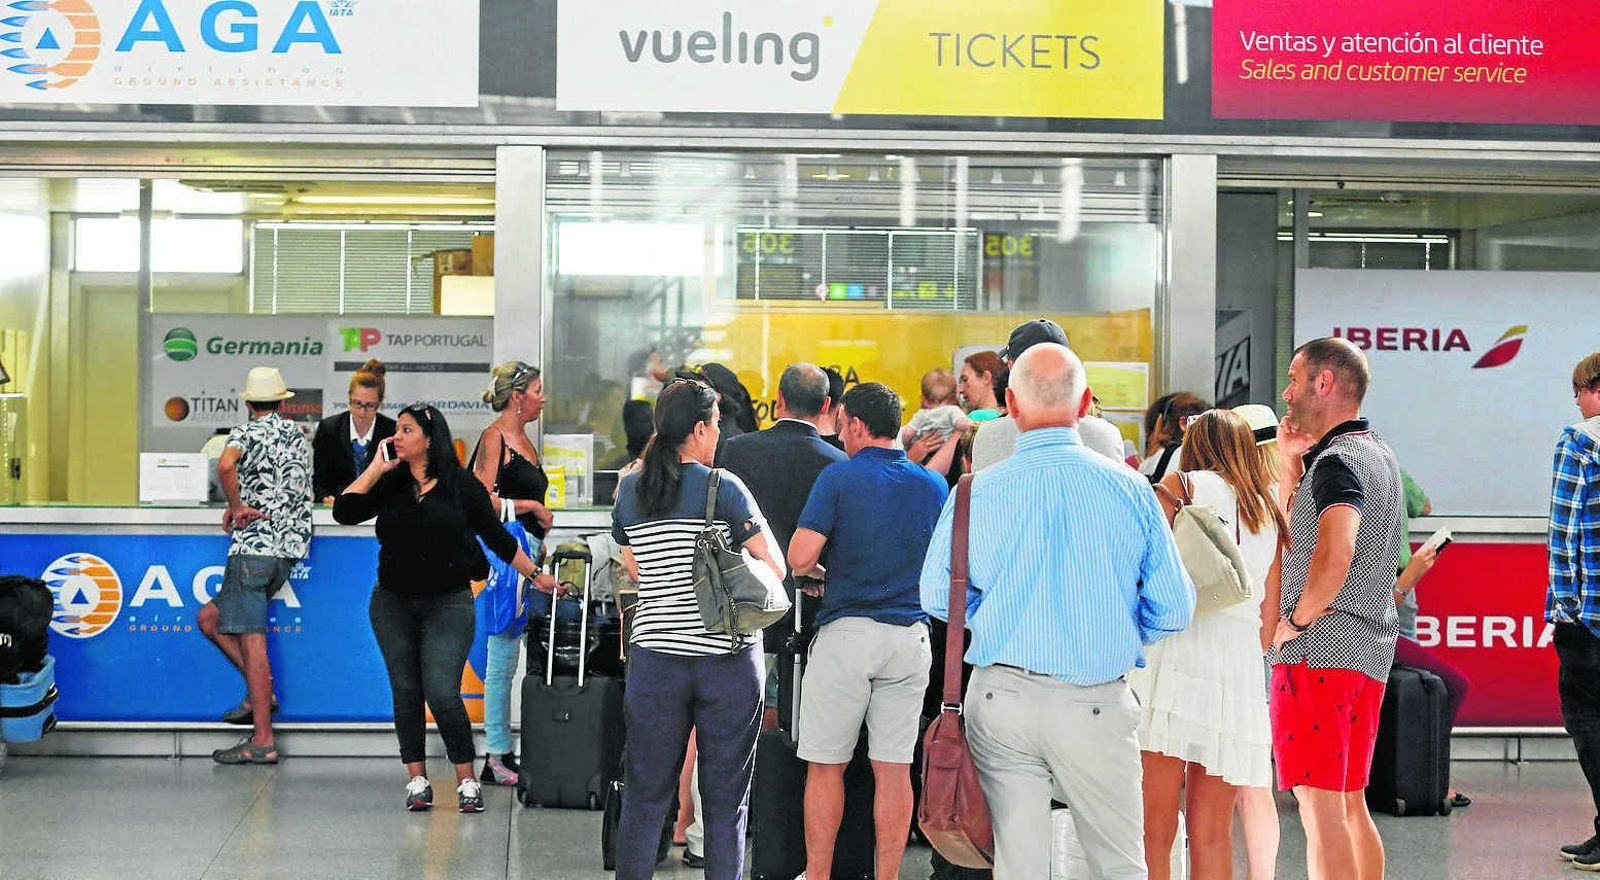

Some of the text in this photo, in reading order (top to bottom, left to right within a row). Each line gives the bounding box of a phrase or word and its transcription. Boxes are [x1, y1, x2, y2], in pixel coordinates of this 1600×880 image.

[114, 0, 343, 53] AGA
[618, 11, 821, 82] vueling
[929, 32, 1101, 70] TICKETS
[1239, 30, 1545, 58] Ventas y atención al cliente
[114, 77, 198, 86] GROUND
[1239, 59, 1528, 84] Sales and customer service
[206, 336, 324, 356] Germania
[190, 397, 239, 413] TITAN
